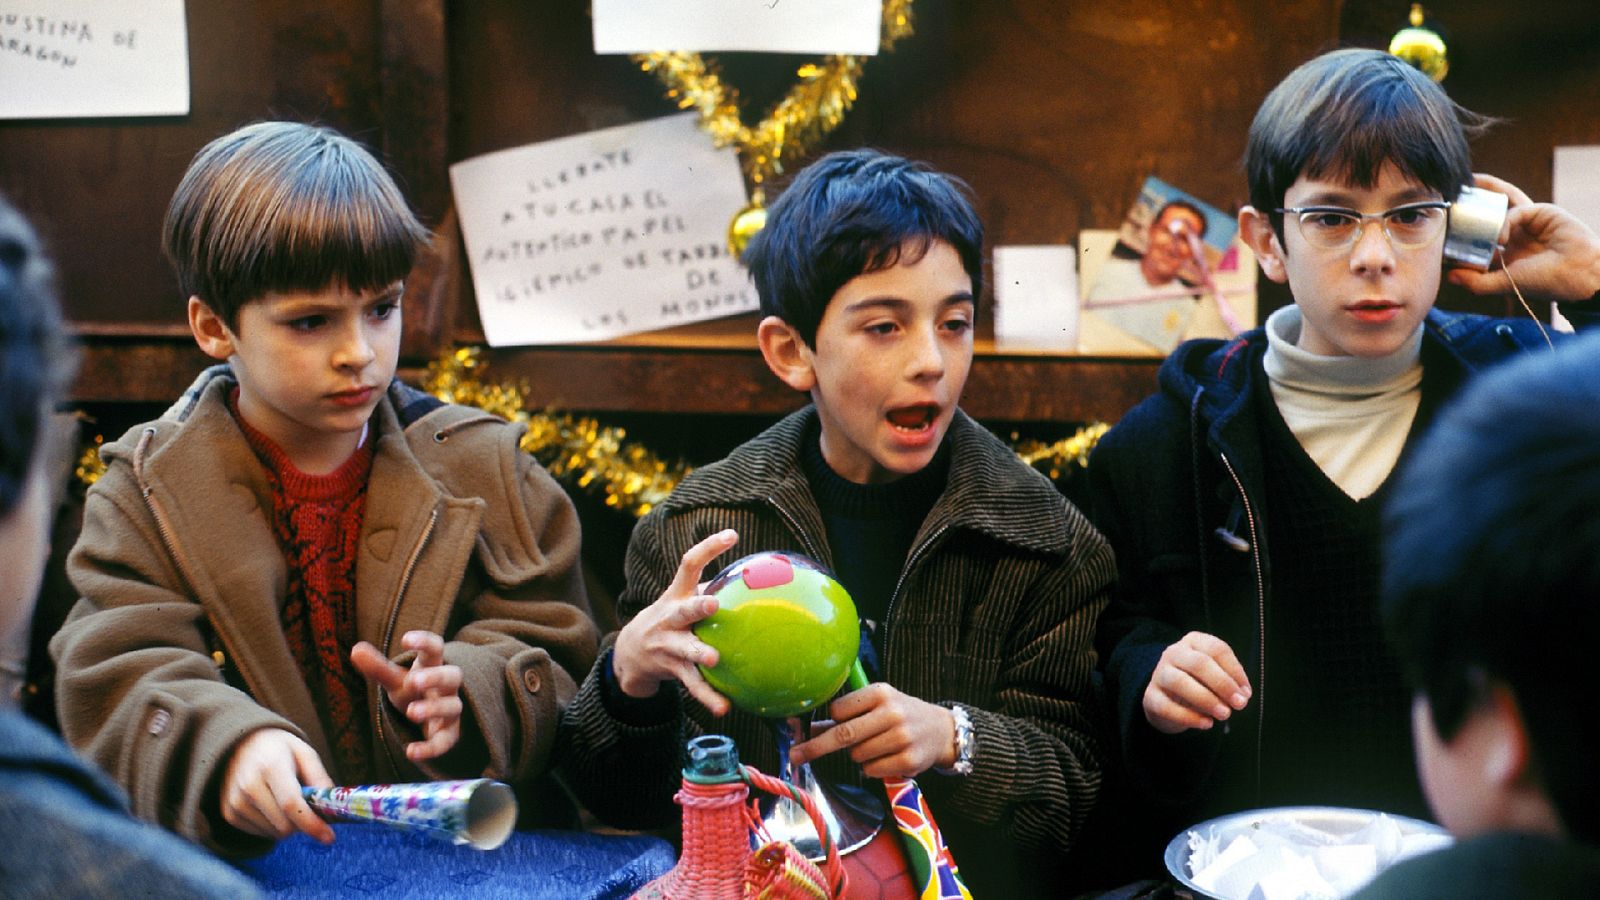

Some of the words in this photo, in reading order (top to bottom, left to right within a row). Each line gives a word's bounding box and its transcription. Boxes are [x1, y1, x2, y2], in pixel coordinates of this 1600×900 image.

[114, 30, 137, 48] DE
[602, 214, 687, 246] PAPEL
[687, 269, 720, 290] DE
